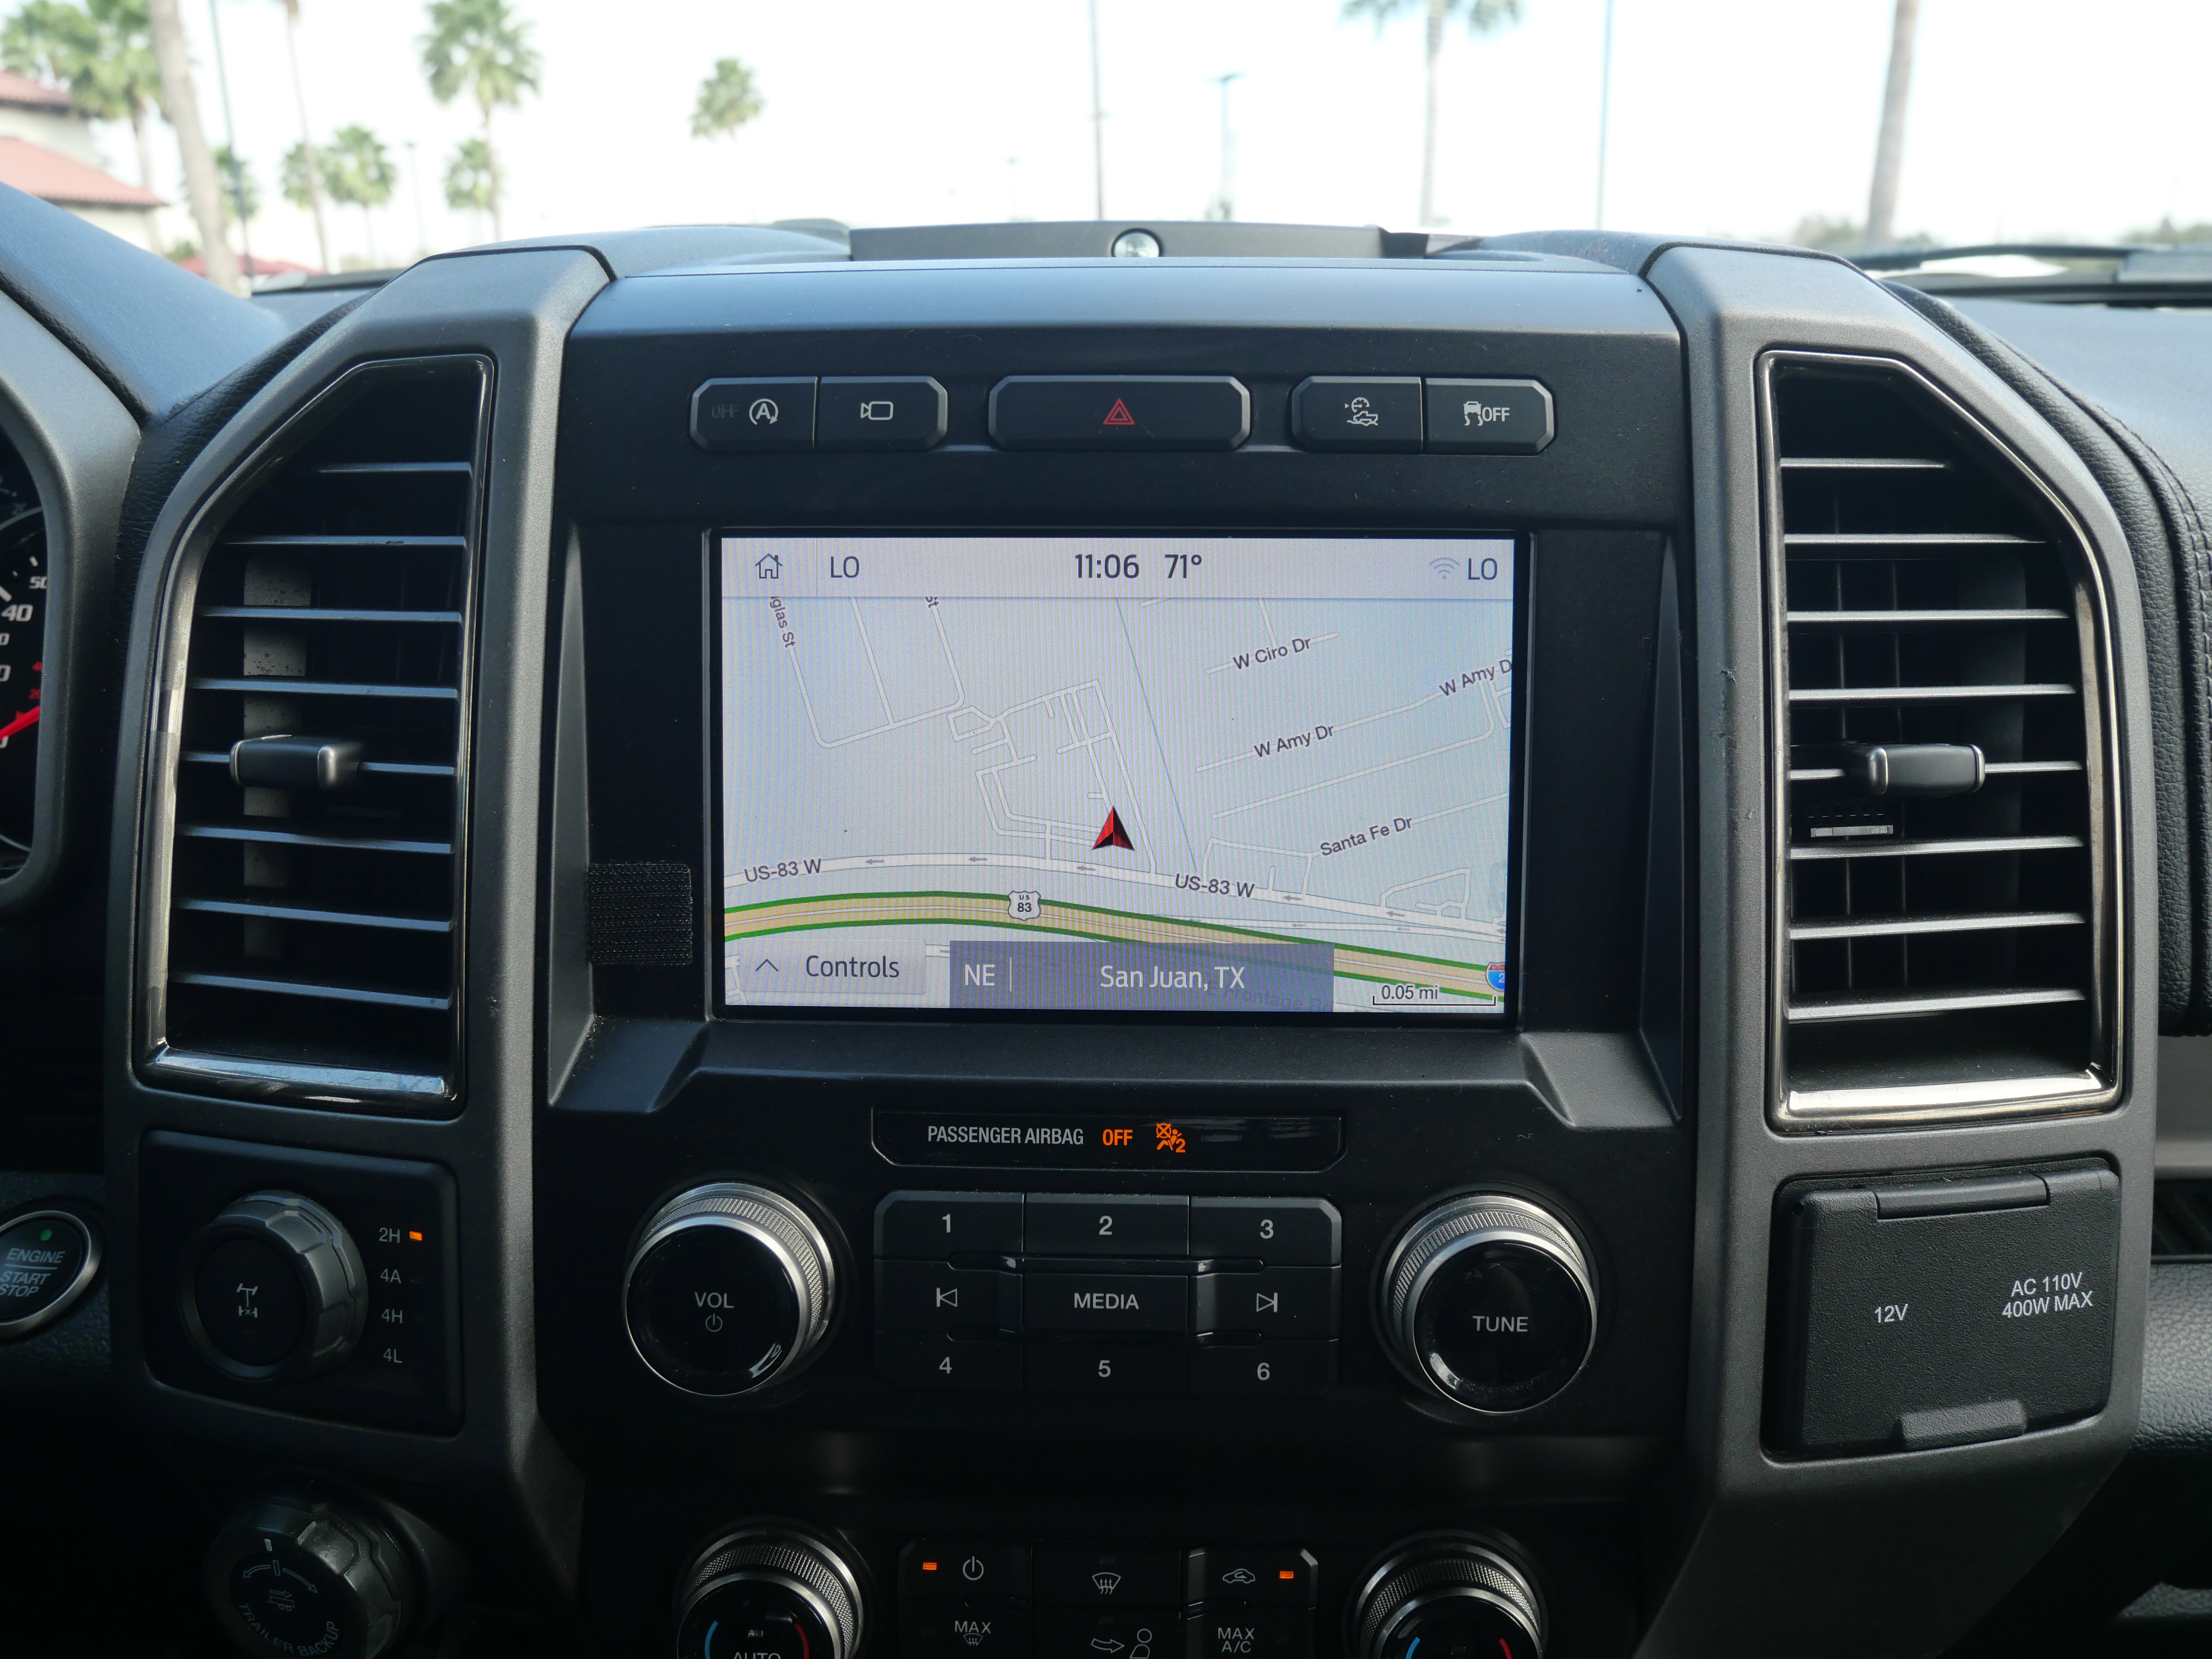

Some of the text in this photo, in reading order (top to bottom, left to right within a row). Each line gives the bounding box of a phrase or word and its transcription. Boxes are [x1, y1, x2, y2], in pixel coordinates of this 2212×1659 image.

[1482, 407, 1510, 422] OFF
[830, 556, 860, 578] LO
[1074, 554, 1202, 579] 11:06 71°
[1468, 558, 1498, 580] LO
[1, 604, 33, 622] 40
[782, 632, 796, 649] St
[1233, 637, 1311, 670] W Ciro Dr
[1439, 659, 1512, 696] W Amy D
[1254, 724, 1335, 757] W Amy Dr
[1320, 816, 1413, 856] Santa Fe Dr
[744, 859, 822, 883] US-83 W
[1175, 873, 1255, 898] US-83 W
[1018, 902, 1031, 912] 83
[806, 956, 899, 978] Controls
[964, 964, 995, 986] NE
[1100, 966, 1245, 991] San Juan, TX
[1382, 985, 1438, 999] 0.05 mi
[928, 1126, 1132, 1146] PASSENGER AIRBAG OFF
[942, 1214, 951, 1233] 1
[1098, 1216, 1113, 1235] 2
[1260, 1220, 1274, 1240] 3
[379, 1227, 400, 1243] 2H
[7, 1247, 66, 1263] ENGINE
[1, 1270, 51, 1285] START
[381, 1269, 402, 1284] 4A
[2011, 1272, 2082, 1297] AC 110V
[0, 1284, 39, 1297] STOP
[695, 1292, 734, 1308] VOL
[1074, 1293, 1139, 1310] MEDIA
[2002, 1291, 2093, 1318] 400W MAX
[381, 1308, 403, 1324] 4H
[1875, 1304, 1908, 1322] 12V
[1473, 1316, 1528, 1332] TUNE
[384, 1348, 403, 1363] 4L
[939, 1356, 952, 1374] 4
[1097, 1359, 1111, 1377] 5
[1256, 1362, 1270, 1380] 6
[239, 1603, 340, 1656] TRAILER BACKUP
[955, 1621, 991, 1634] MAX
[1217, 1628, 1255, 1641] MAX
[1222, 1640, 1252, 1653] A/C
